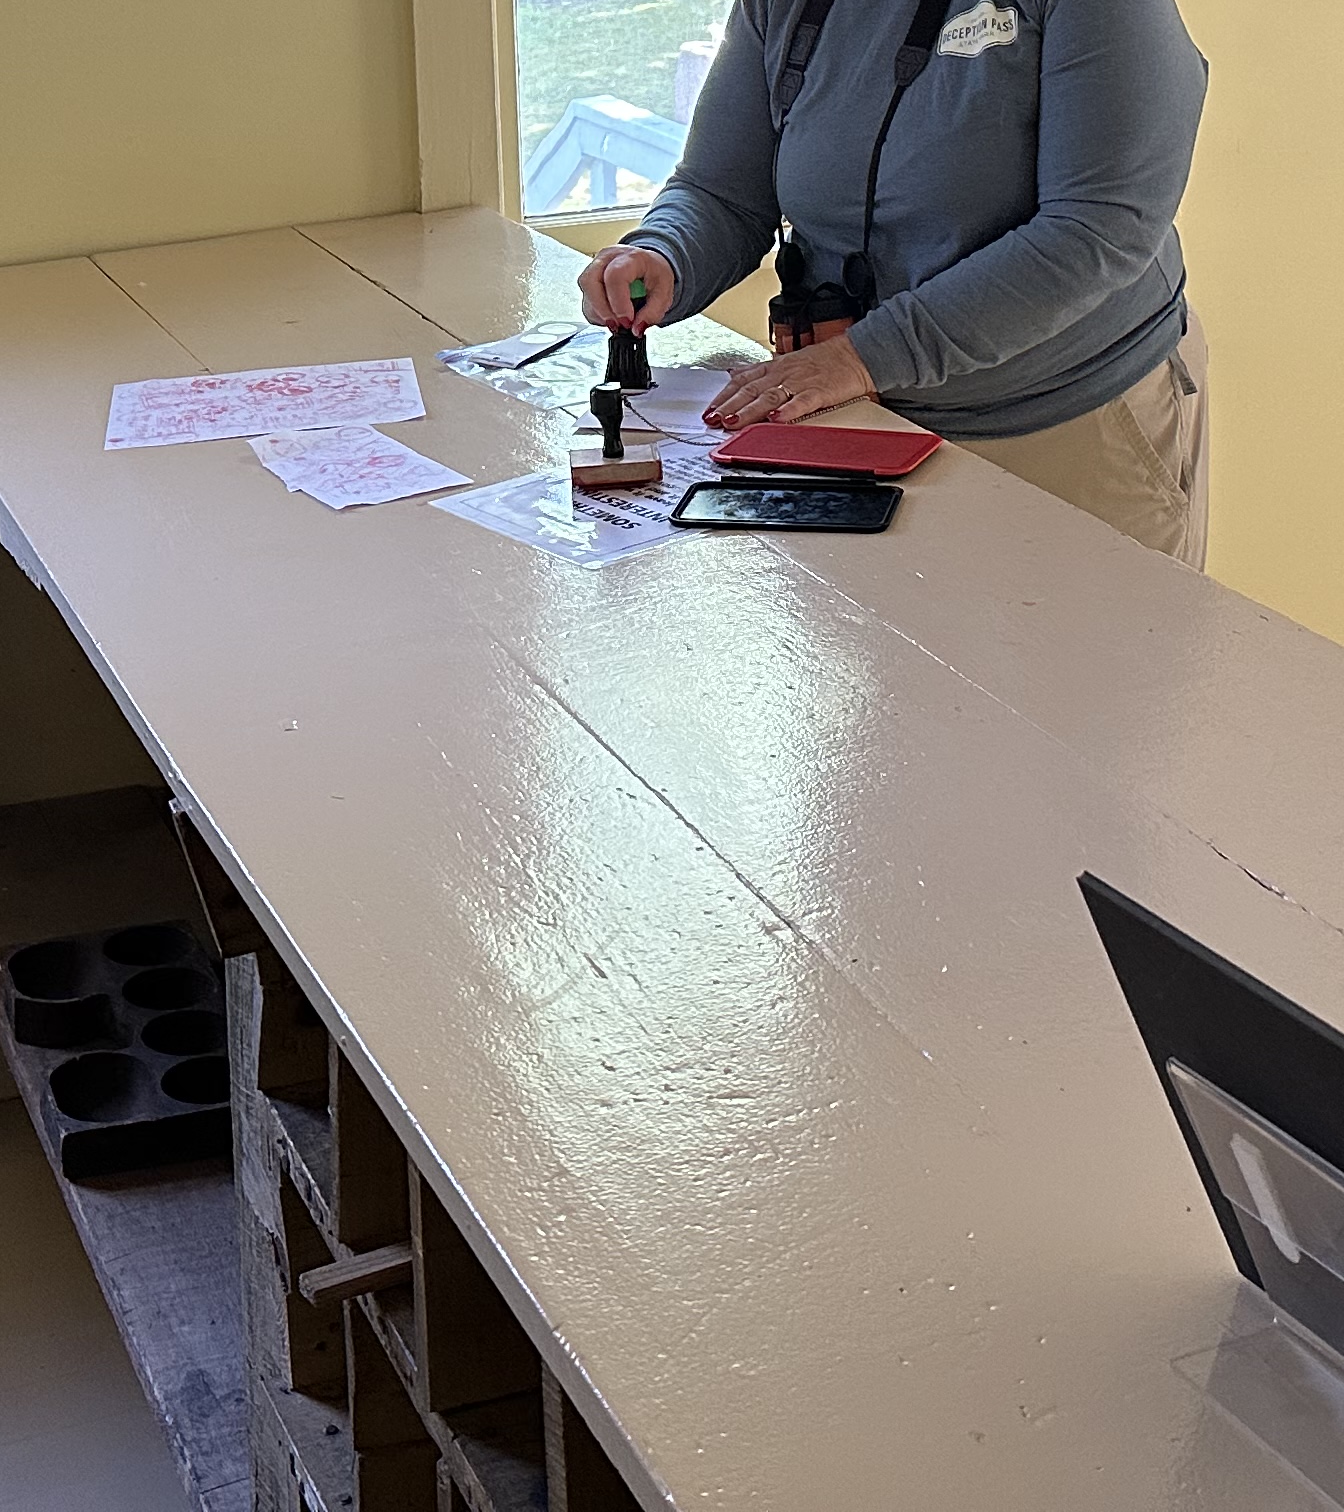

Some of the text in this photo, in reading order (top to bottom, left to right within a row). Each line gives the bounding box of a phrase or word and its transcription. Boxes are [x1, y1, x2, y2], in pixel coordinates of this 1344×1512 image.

[992, 18, 1014, 32] PASS
[573, 501, 642, 530] SOMETH
[576, 488, 669, 523] INTERESTIN
